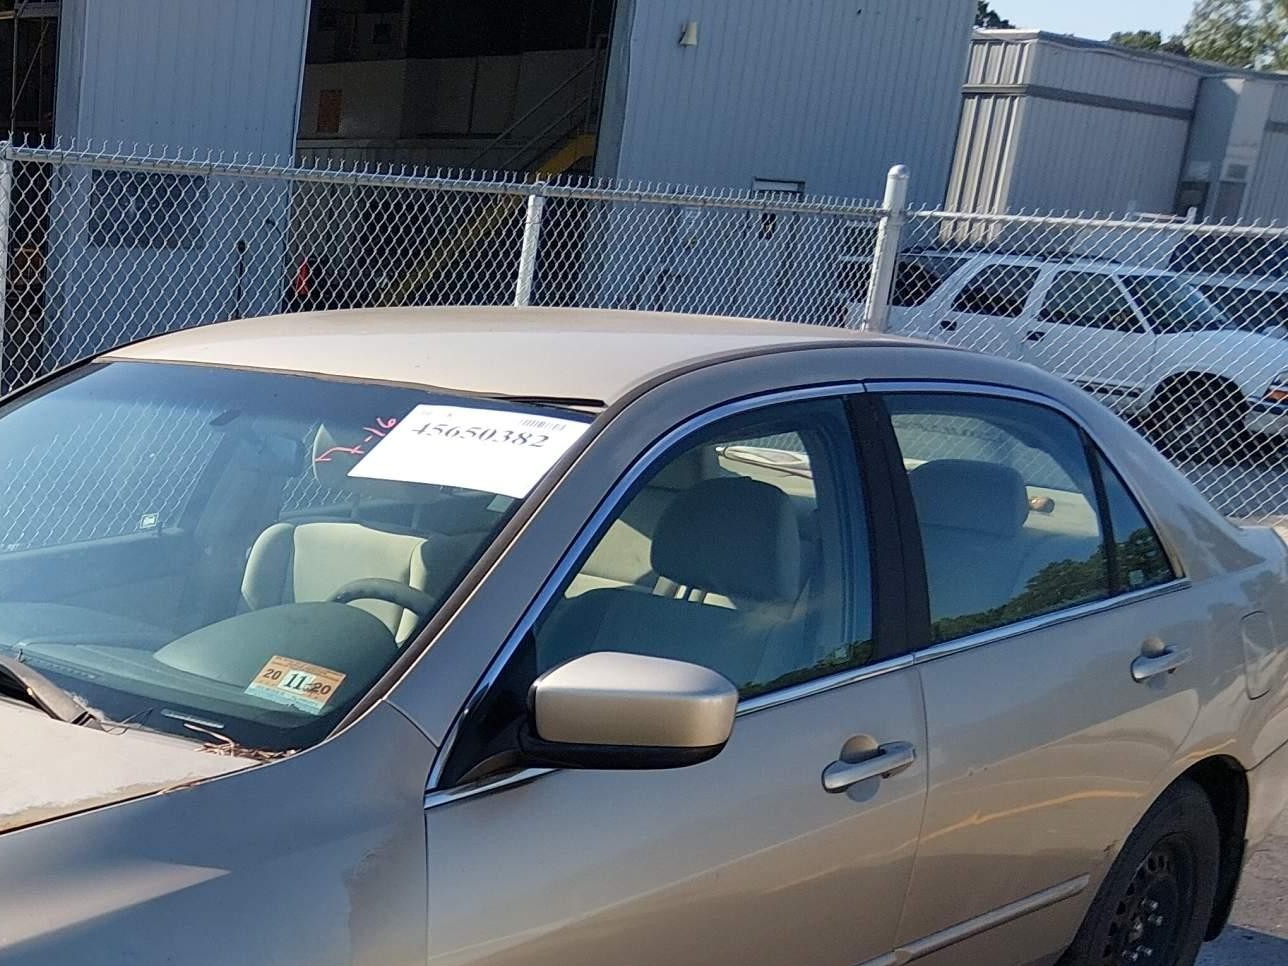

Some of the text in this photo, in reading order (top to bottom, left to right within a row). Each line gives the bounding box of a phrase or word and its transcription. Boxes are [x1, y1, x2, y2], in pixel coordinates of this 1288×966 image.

[411, 422, 550, 448] 45650382
[263, 668, 282, 681] 20
[284, 673, 308, 690] 11
[312, 682, 332, 695] 20
